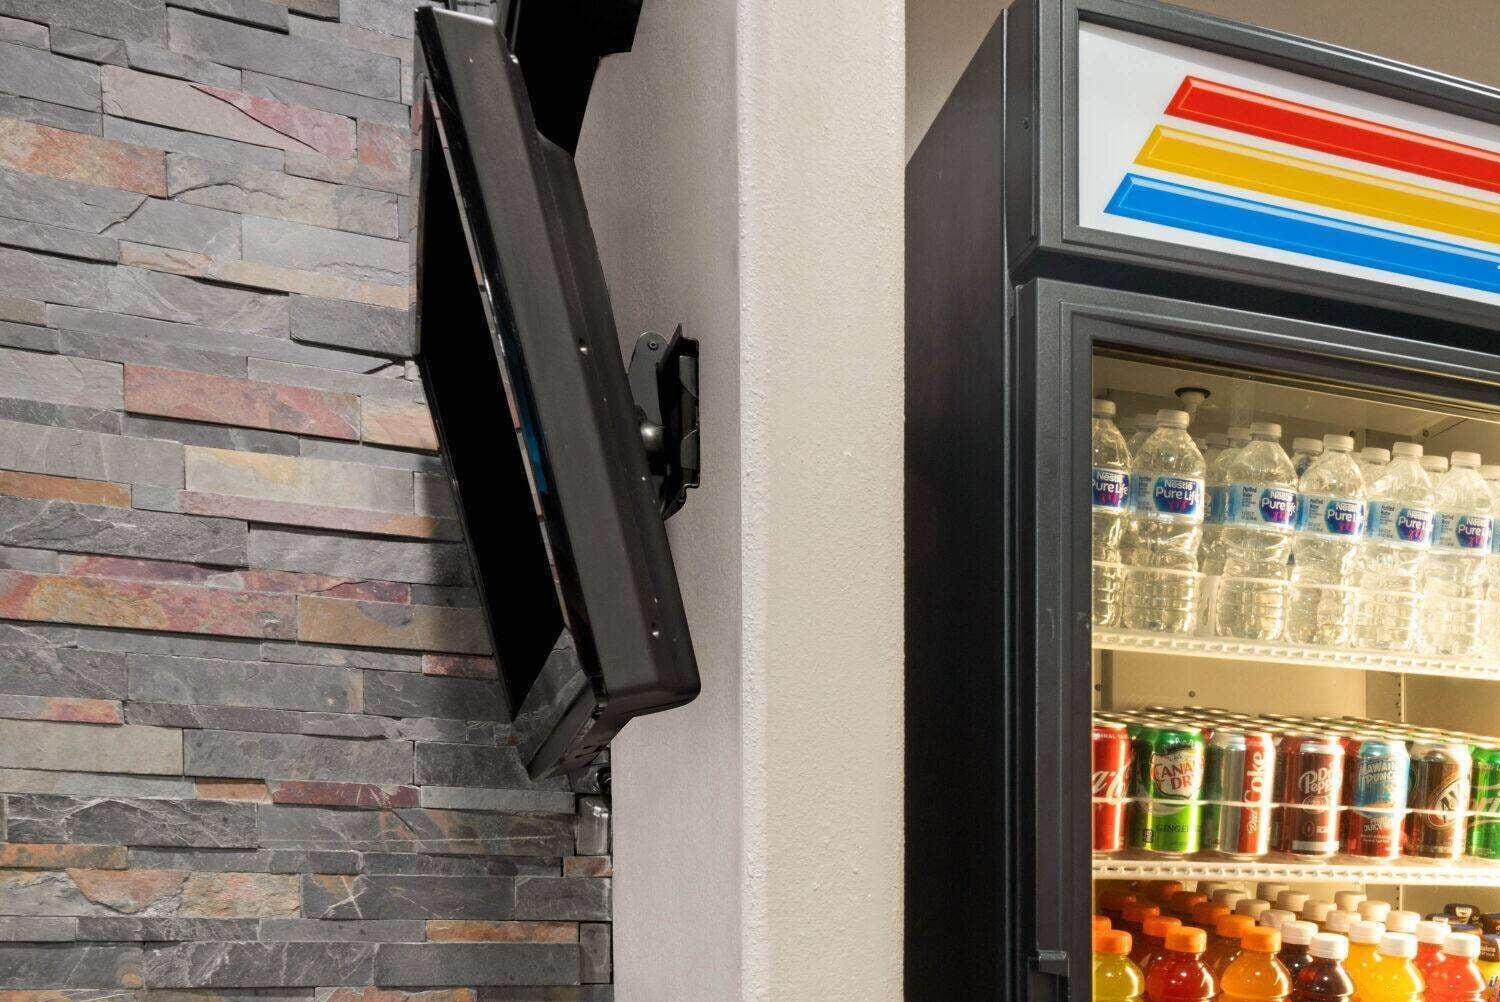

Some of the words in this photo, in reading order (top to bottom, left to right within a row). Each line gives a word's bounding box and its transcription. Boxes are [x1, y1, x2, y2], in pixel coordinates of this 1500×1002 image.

[1156, 487, 1183, 500] Pure
[1262, 497, 1286, 510] Pure
[1327, 509, 1352, 522] Pure
[1399, 516, 1422, 530] Pure
[1458, 524, 1482, 536] Pure
[1244, 751, 1265, 805] Coke
